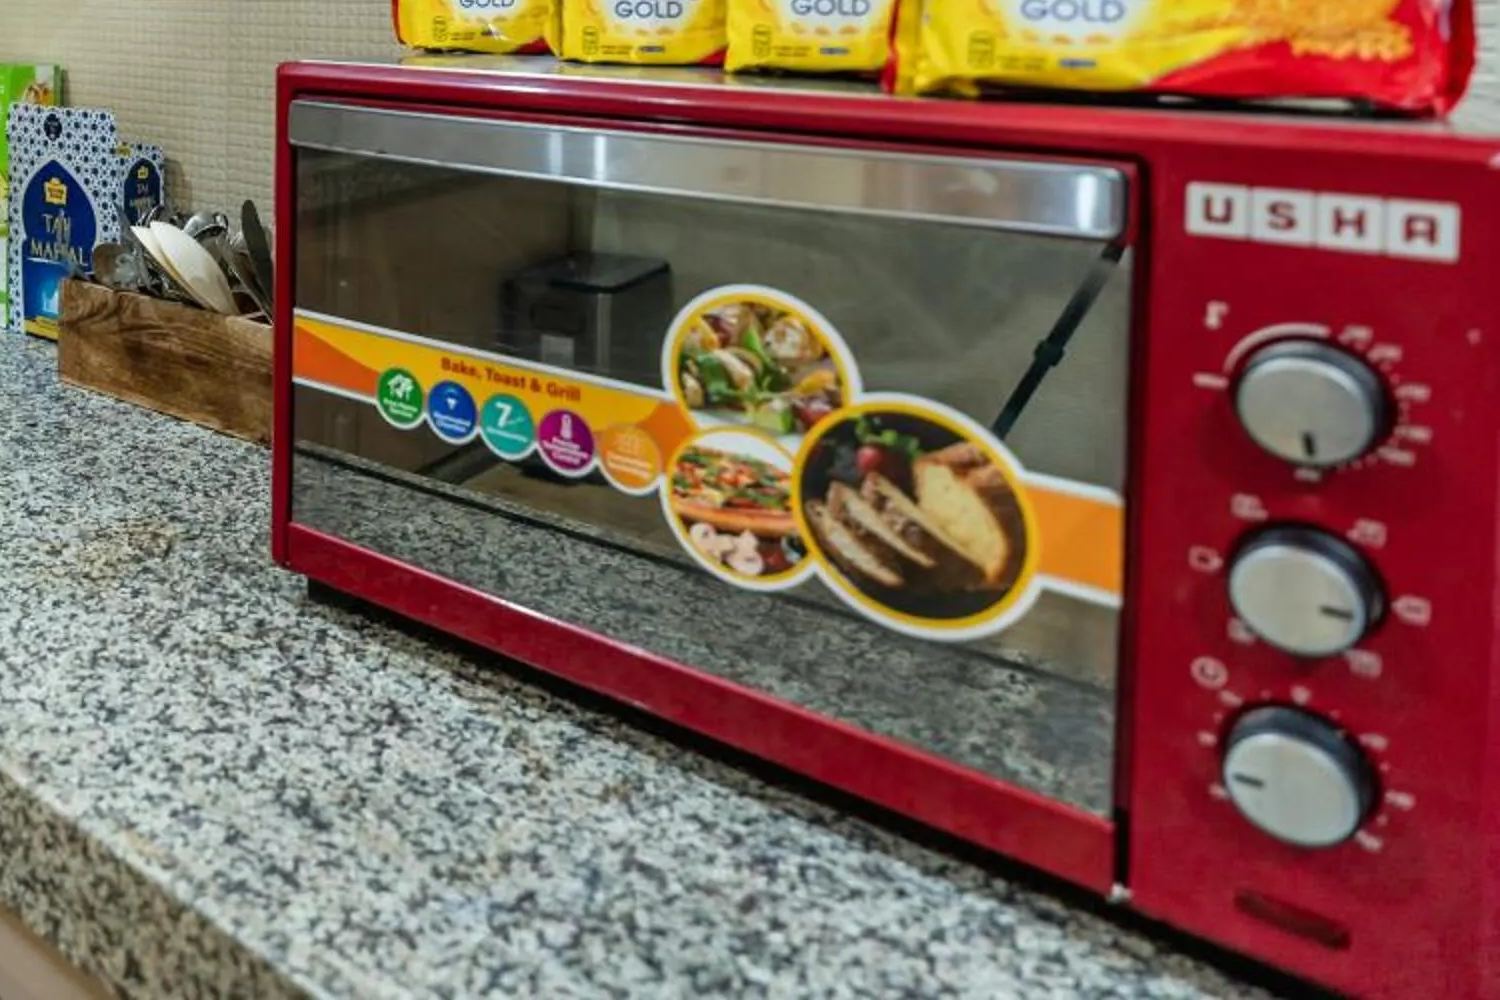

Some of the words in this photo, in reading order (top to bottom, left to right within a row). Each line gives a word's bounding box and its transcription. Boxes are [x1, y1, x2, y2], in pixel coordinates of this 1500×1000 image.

[614, 0, 683, 19] GOLD
[1200, 191, 1443, 249] USHA
[440, 356, 481, 379] Bake,
[485, 366, 527, 389] Toast
[530, 377, 541, 393] &
[546, 381, 581, 401] Grill
